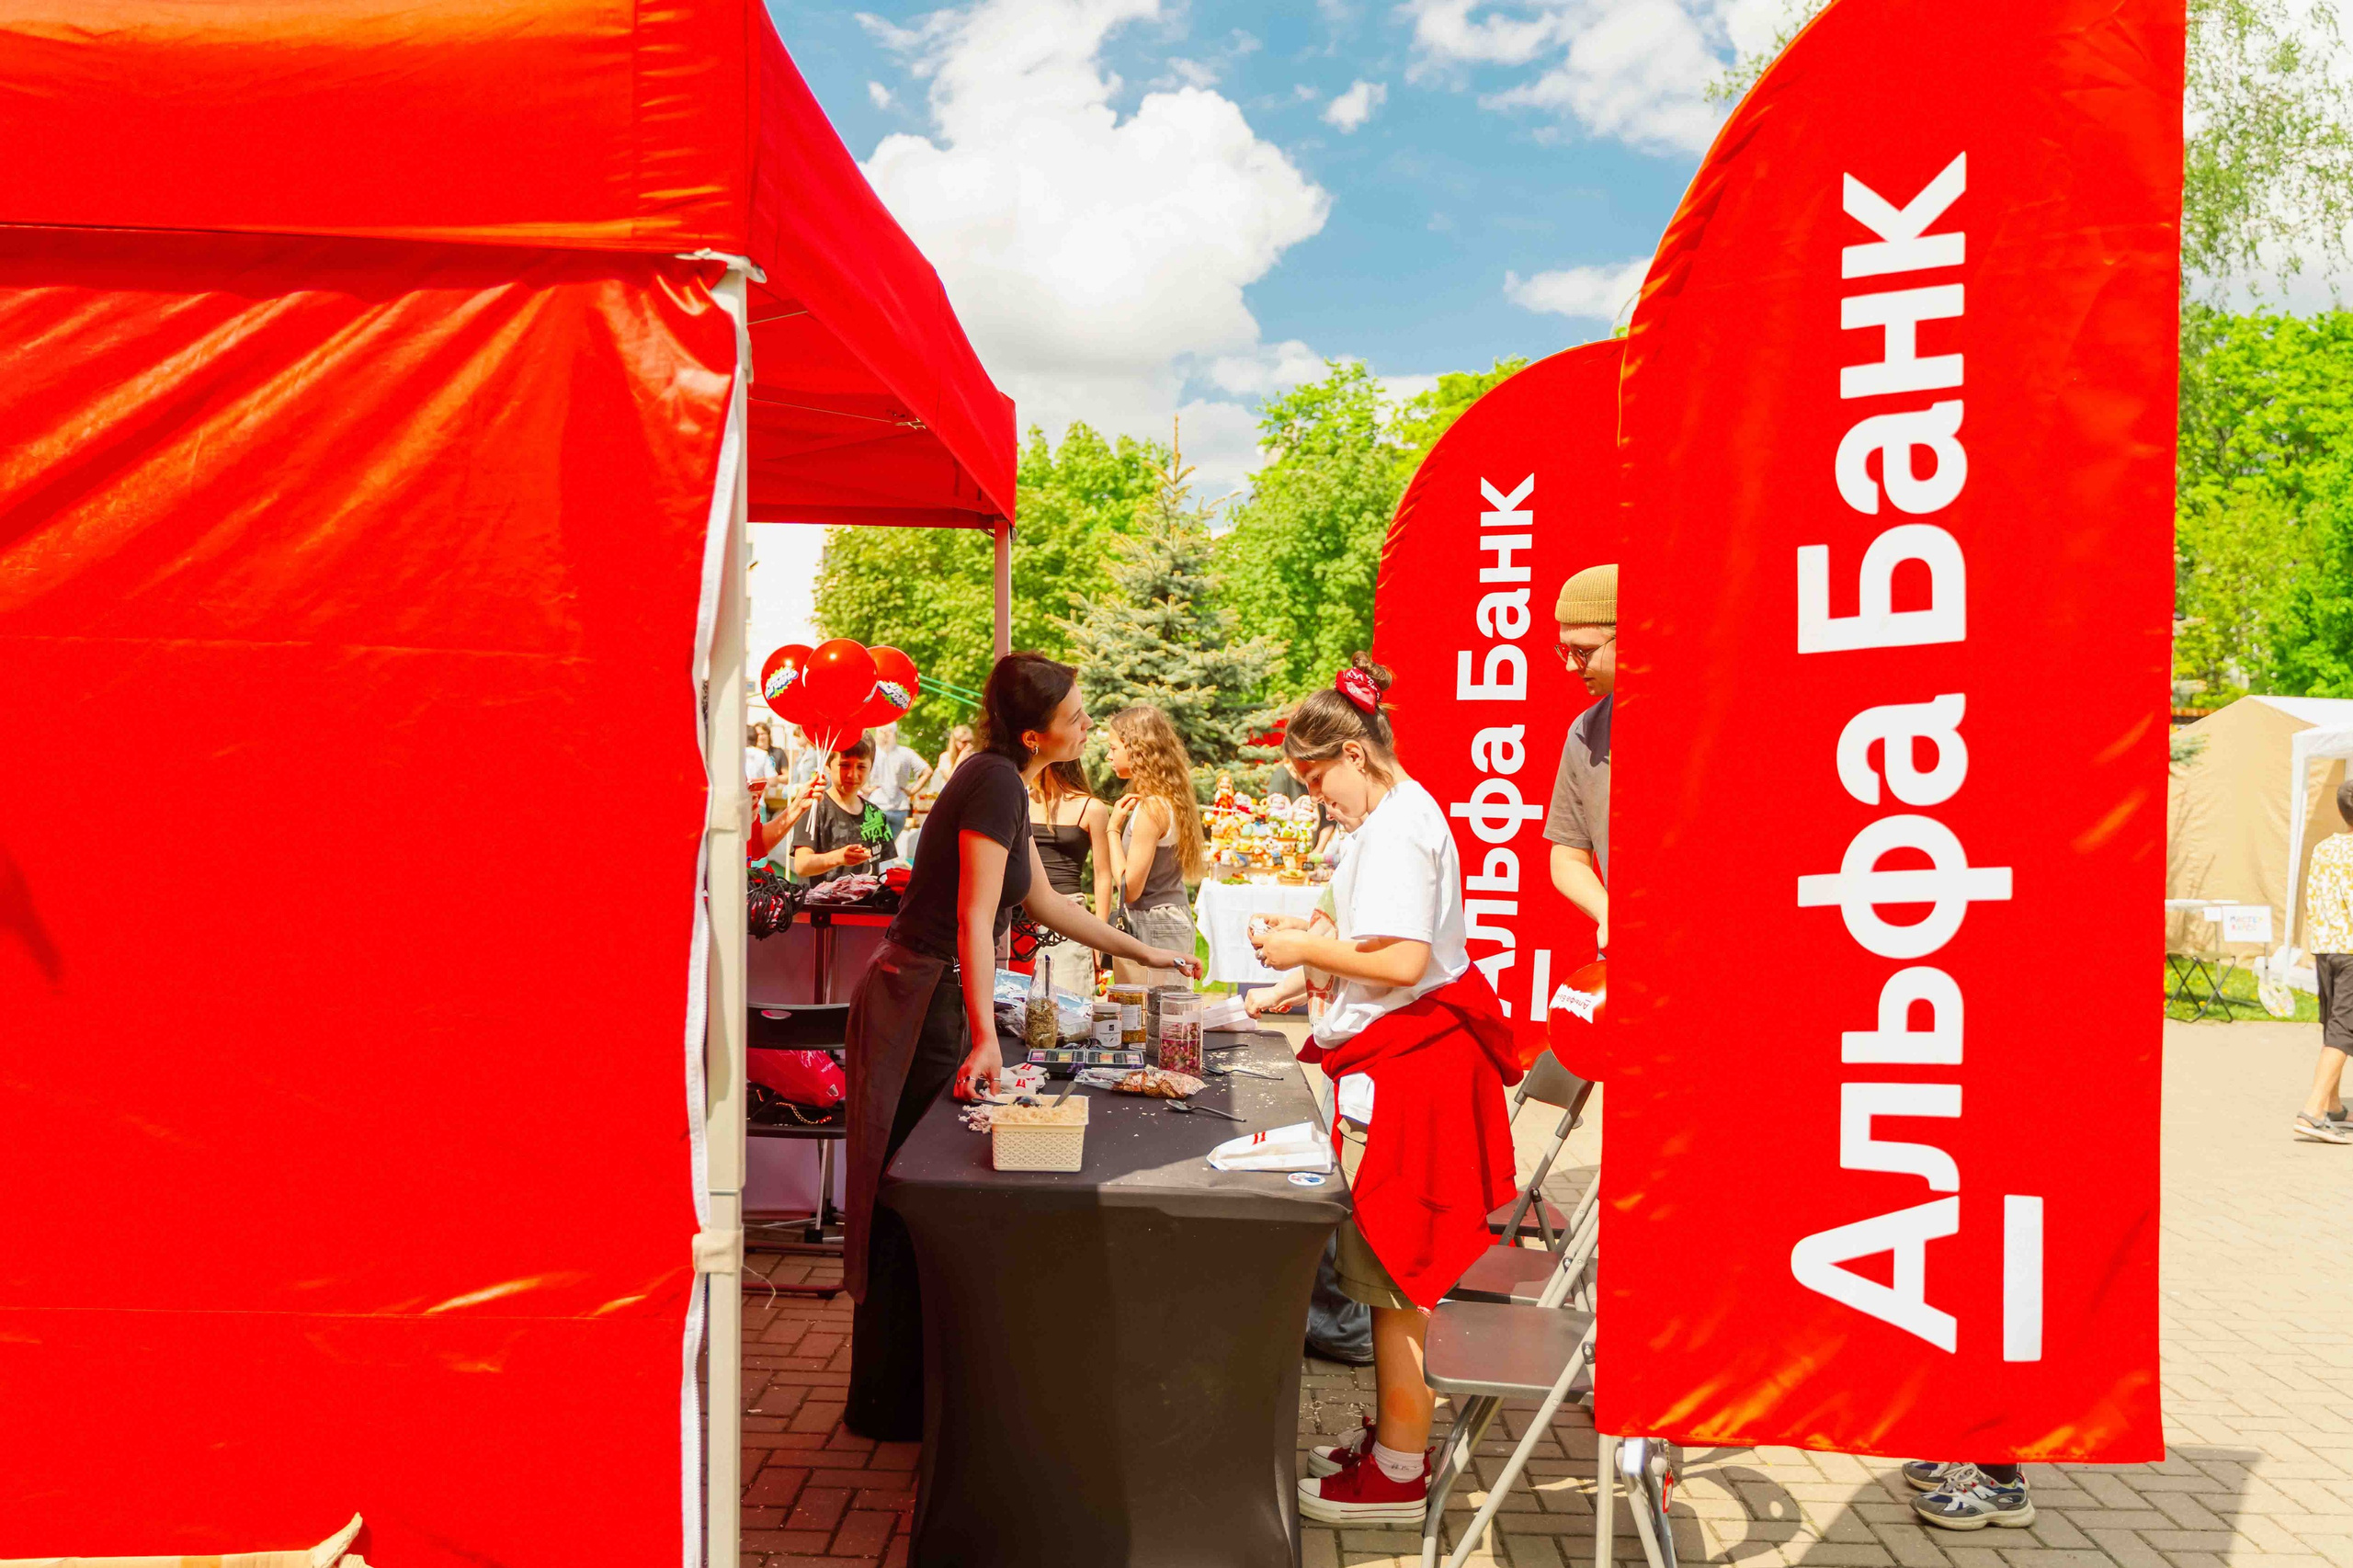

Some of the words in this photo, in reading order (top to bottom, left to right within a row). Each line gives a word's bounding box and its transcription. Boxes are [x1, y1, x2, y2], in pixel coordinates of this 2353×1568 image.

[1798, 152, 1967, 653] Банк
[1457, 473, 1534, 700] Банк
[1566, 995, 1589, 1009] Альфа
[1791, 694, 2012, 1353] Альфа
